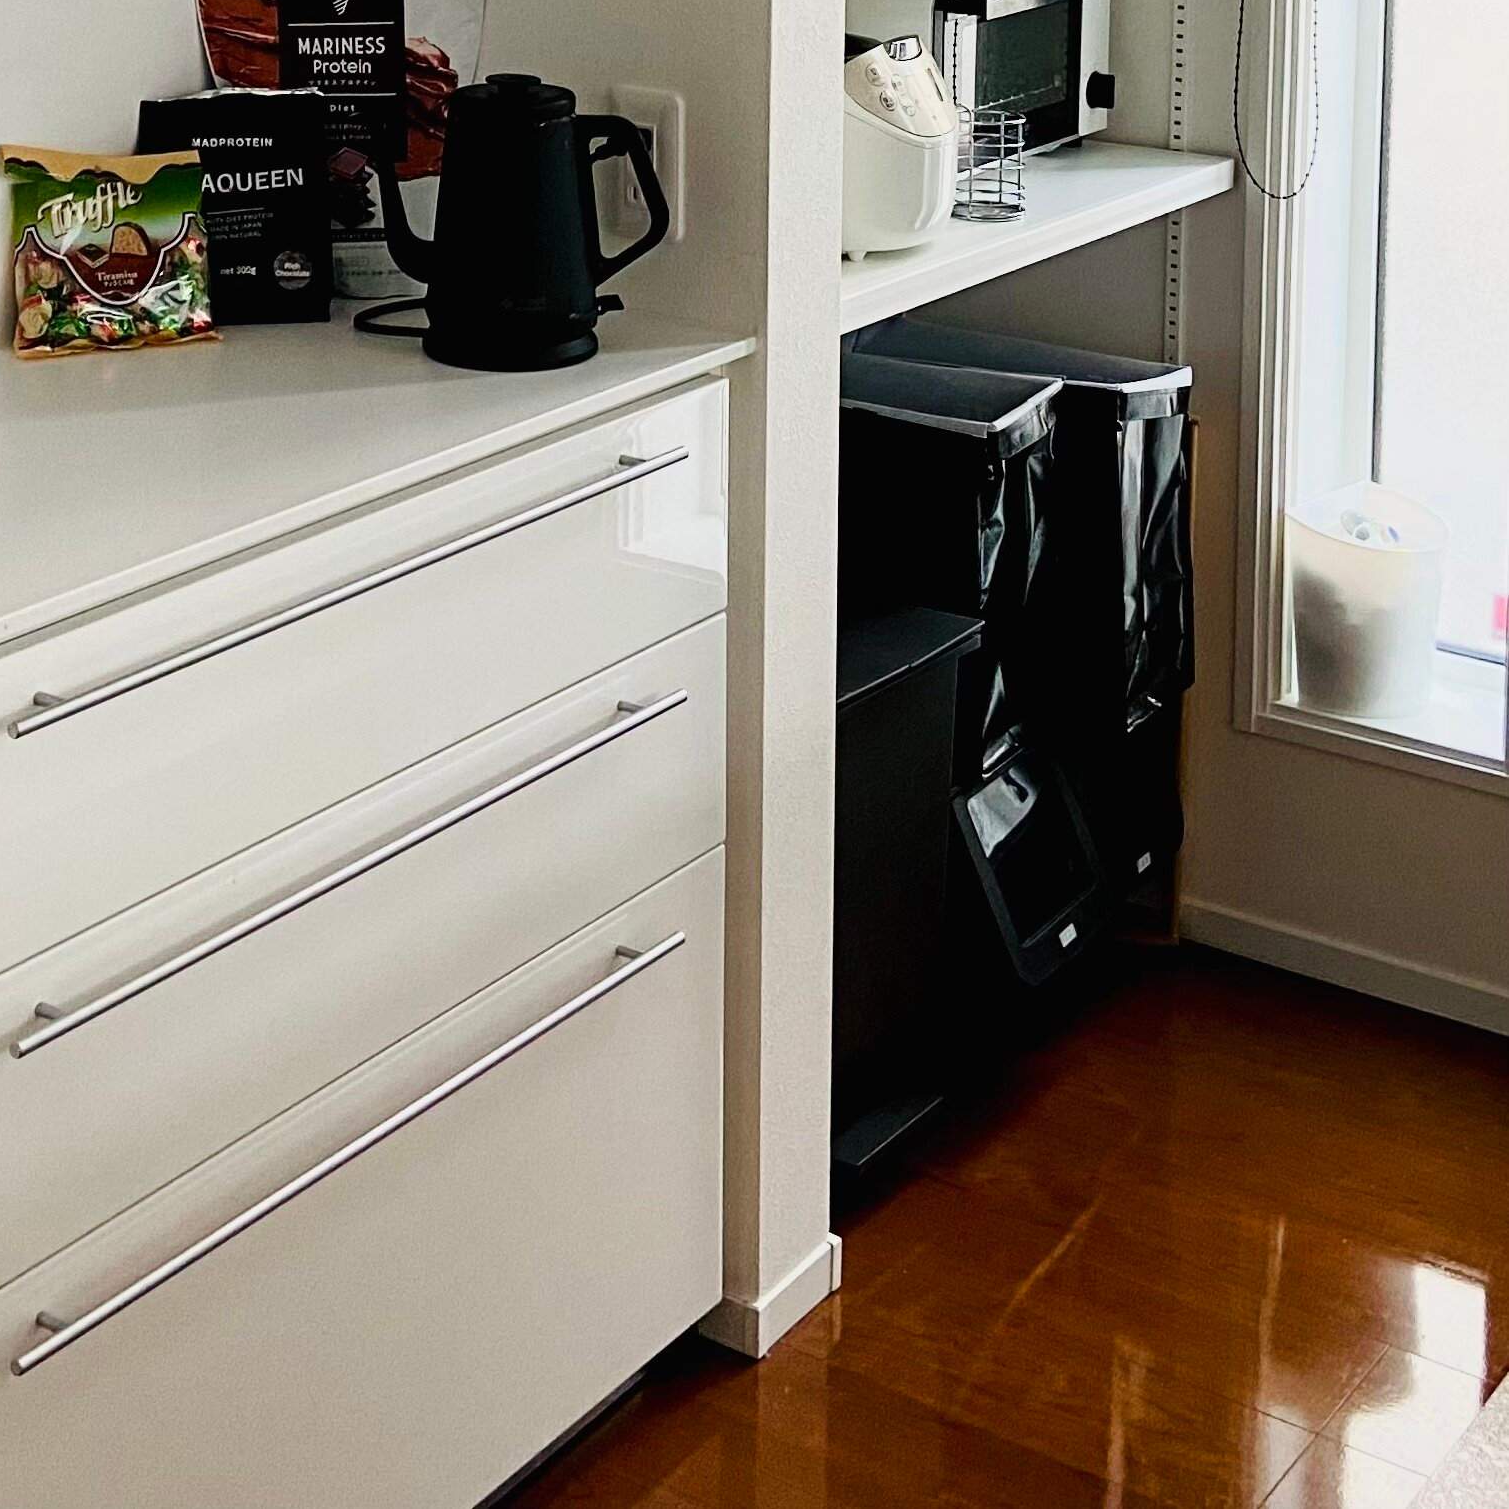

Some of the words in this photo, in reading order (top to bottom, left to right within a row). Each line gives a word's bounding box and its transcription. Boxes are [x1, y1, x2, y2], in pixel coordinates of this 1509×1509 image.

[297, 36, 386, 55] MARINESS
[313, 58, 372, 74] Protein
[329, 104, 356, 112] Diet
[192, 137, 273, 148] MADPROTEIN
[201, 168, 304, 193] AQUEEN
[38, 181, 142, 239] Truffle
